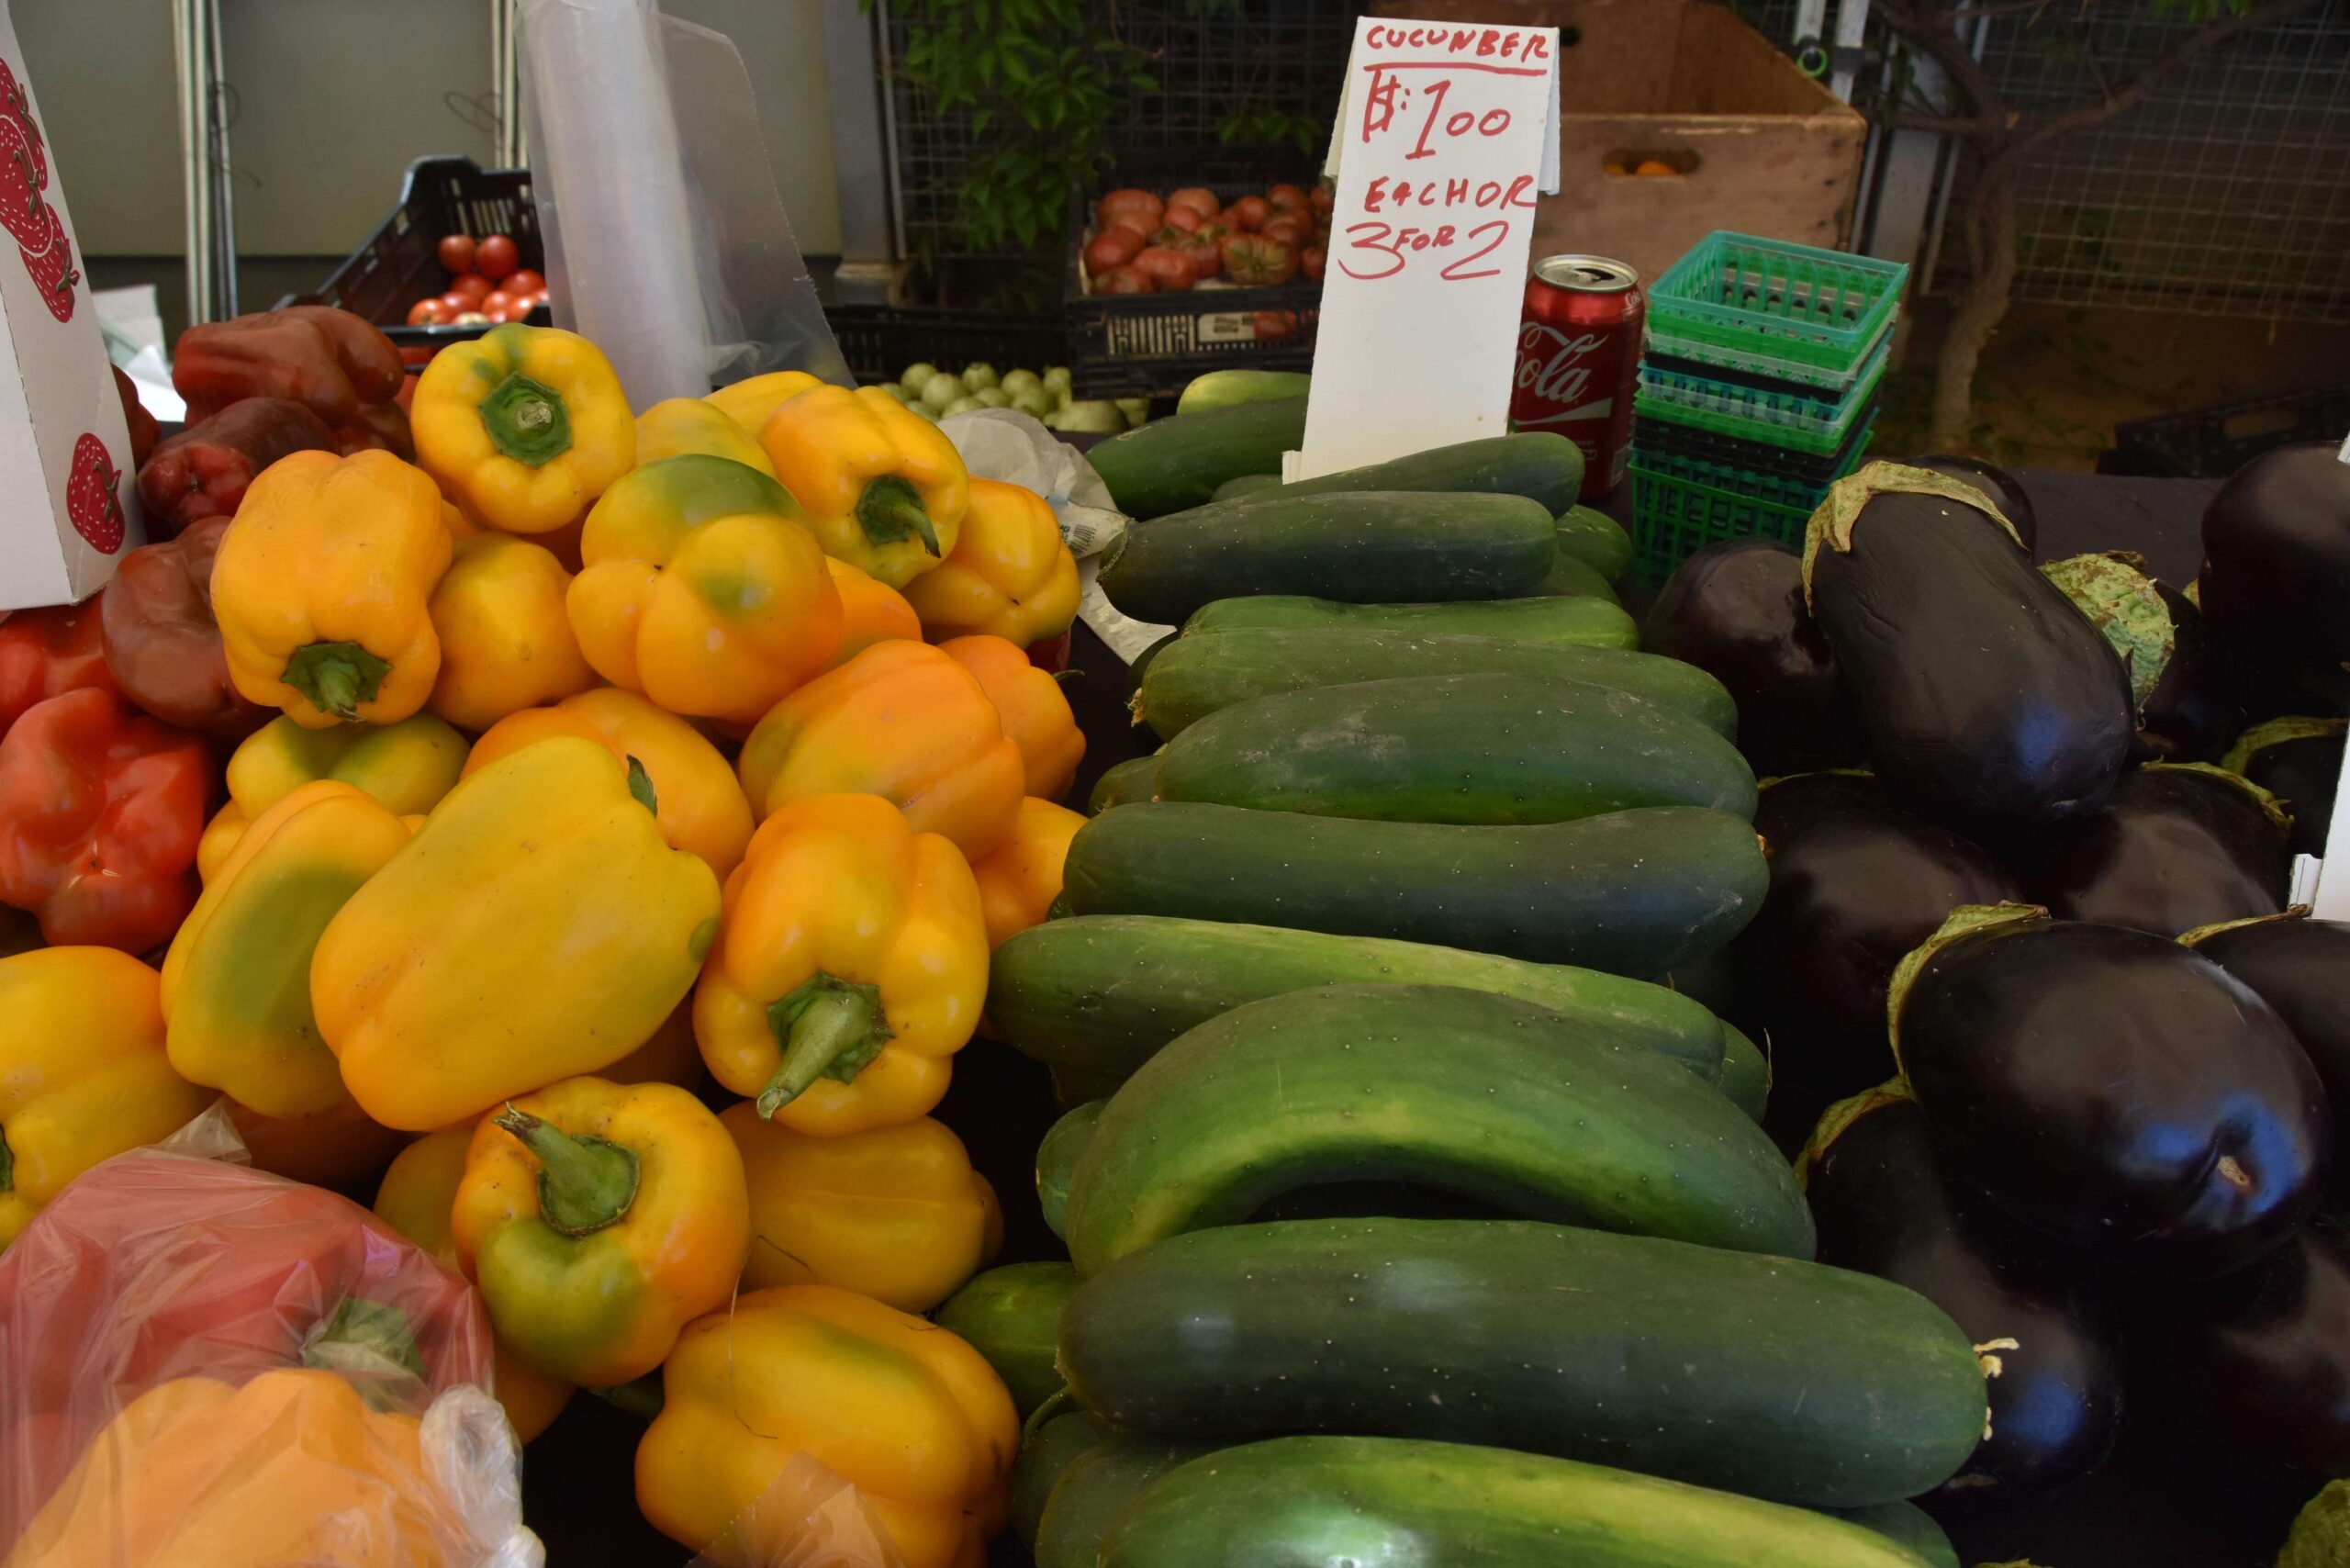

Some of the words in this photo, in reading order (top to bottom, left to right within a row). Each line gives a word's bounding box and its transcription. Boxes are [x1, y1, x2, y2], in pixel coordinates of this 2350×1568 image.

[1338, 222, 1405, 280] 3
[1393, 226, 1456, 252] FOR
[1440, 220, 1509, 281] 2
